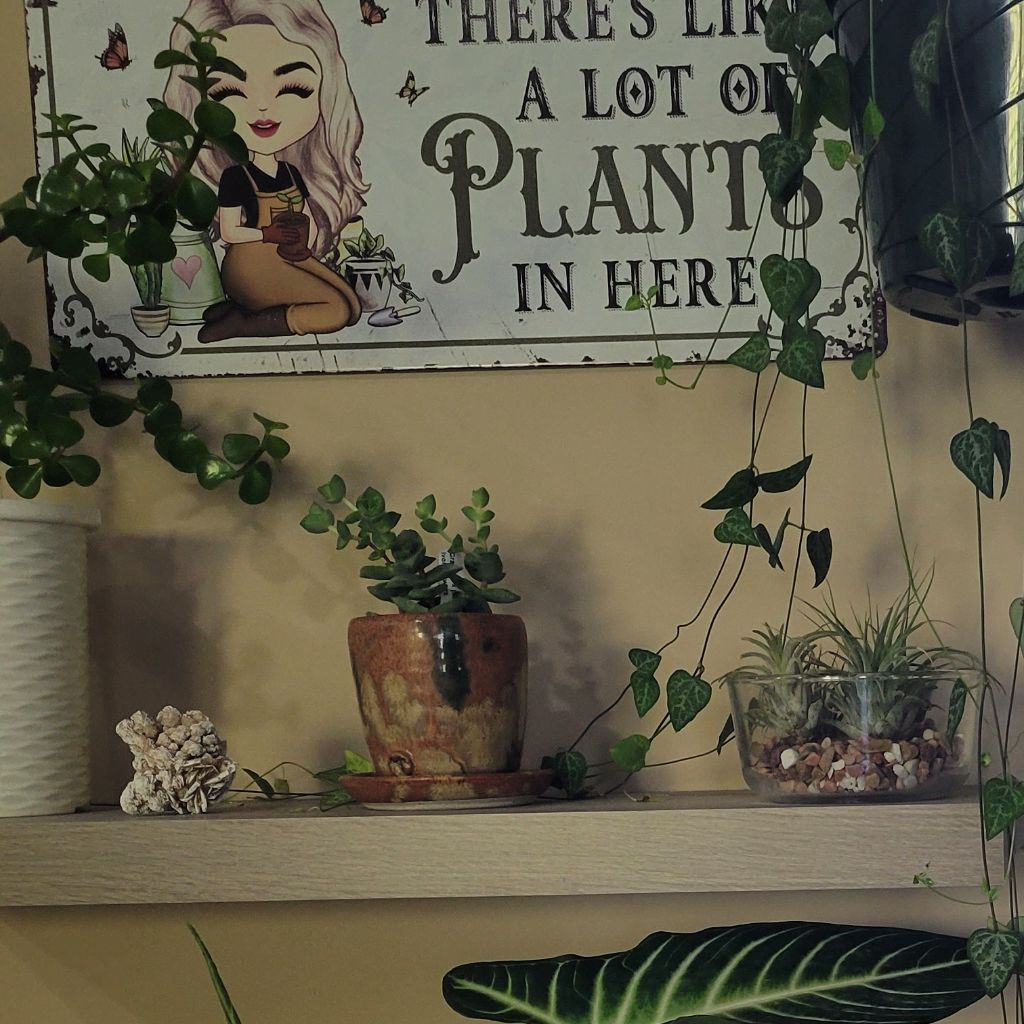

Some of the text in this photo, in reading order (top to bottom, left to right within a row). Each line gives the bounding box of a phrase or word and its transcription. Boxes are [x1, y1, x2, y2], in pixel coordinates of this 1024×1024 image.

[415, 0, 768, 46] THERES LIK
[515, 67, 556, 121] A
[580, 64, 694, 120] LOT
[512, 257, 757, 313] IN HERE
